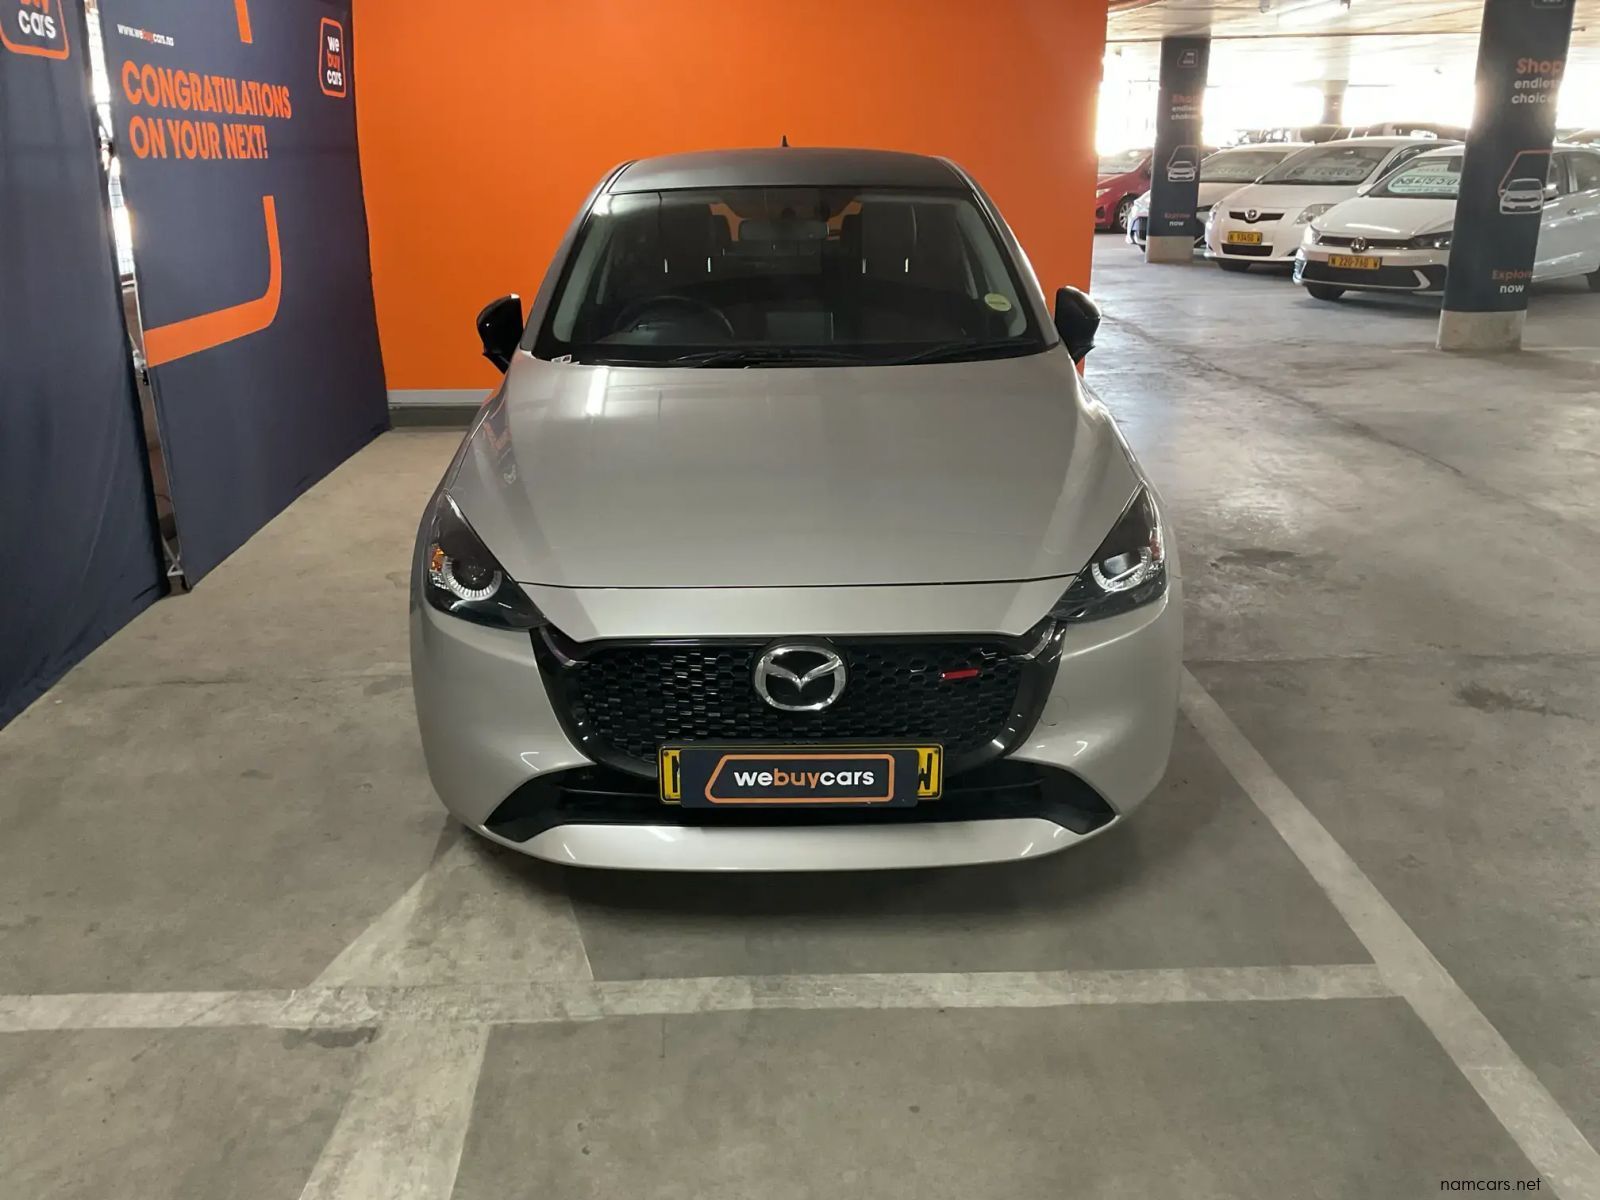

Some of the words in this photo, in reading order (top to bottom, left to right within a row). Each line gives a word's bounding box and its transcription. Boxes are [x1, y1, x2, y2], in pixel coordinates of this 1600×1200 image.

[18, 9, 57, 39] cars
[327, 35, 340, 53] we
[1516, 58, 1564, 76] Shop
[326, 69, 343, 87] cars
[121, 59, 292, 119] CONGRATULATIONS
[128, 115, 168, 159] ON
[166, 118, 223, 160] YOUR
[222, 122, 269, 160] NEXT!
[1500, 284, 1525, 294] now
[733, 767, 875, 789] webuycars
